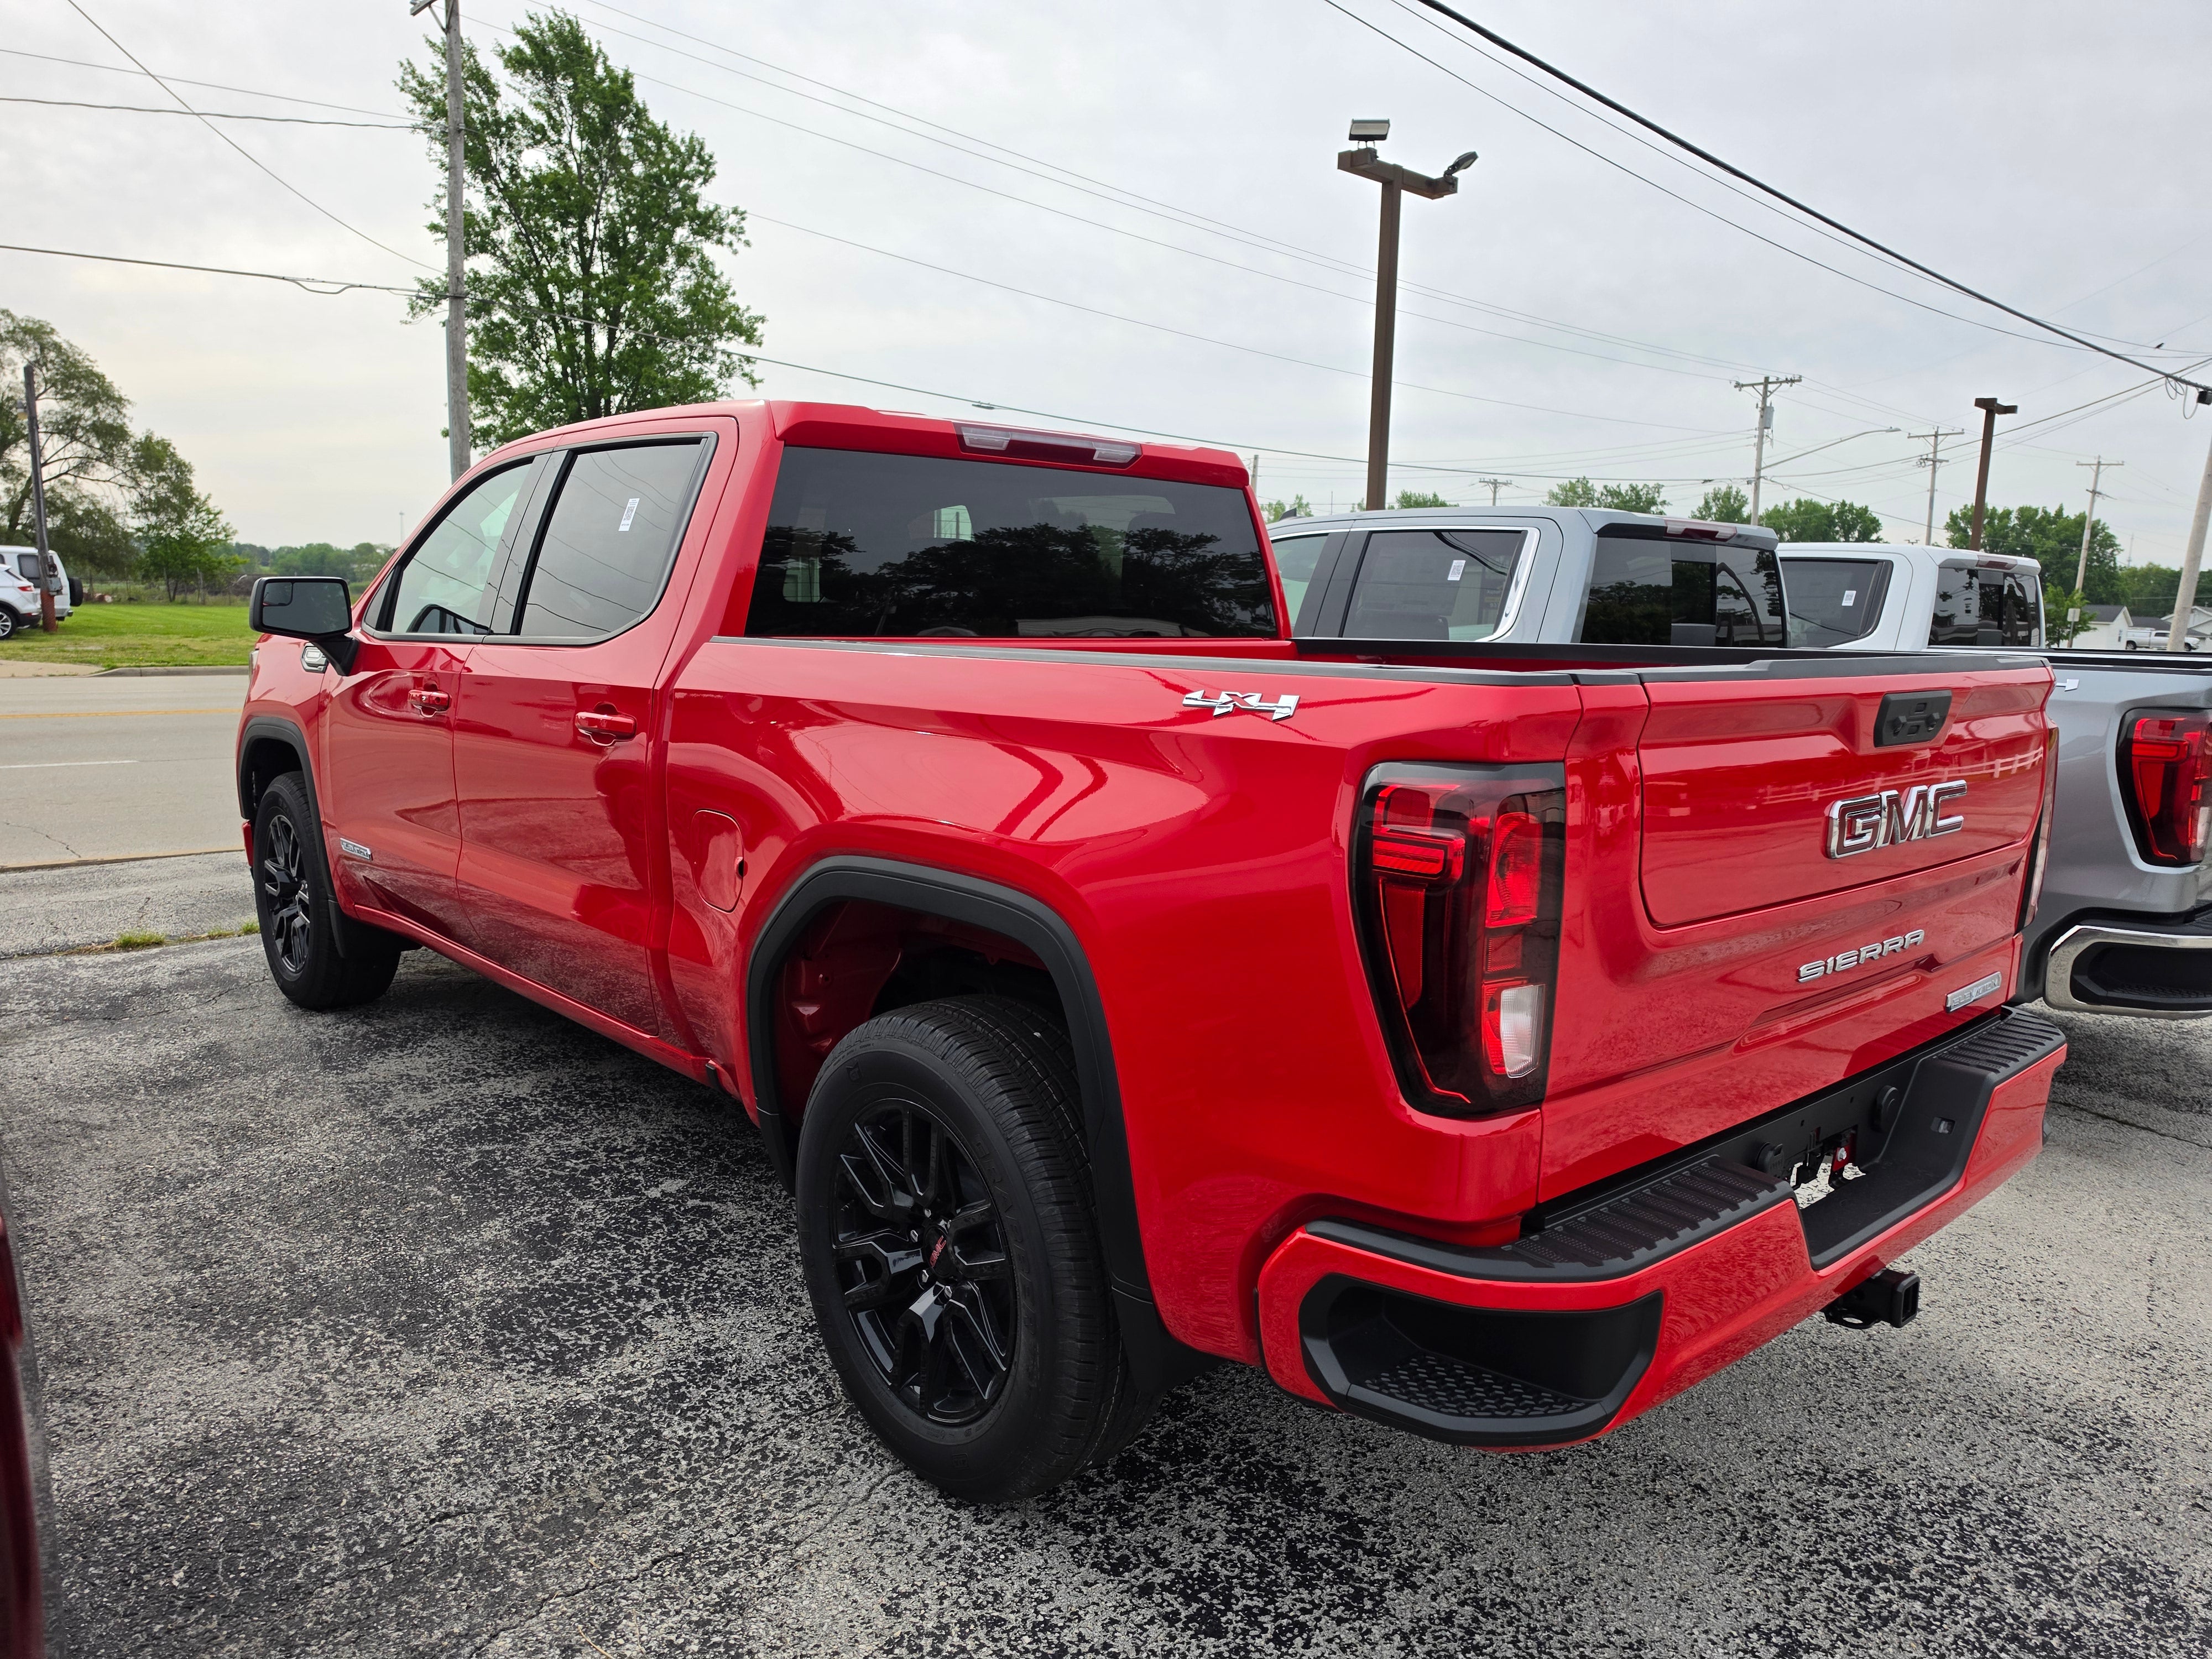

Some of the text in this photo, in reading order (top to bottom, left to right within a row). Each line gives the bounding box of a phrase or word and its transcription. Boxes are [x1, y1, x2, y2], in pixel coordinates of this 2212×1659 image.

[1824, 779, 1967, 859] GMC
[1797, 929, 1924, 983] SIERRA
[1952, 978, 1999, 1006] ELEVATION
[930, 1235, 947, 1268] GMC
